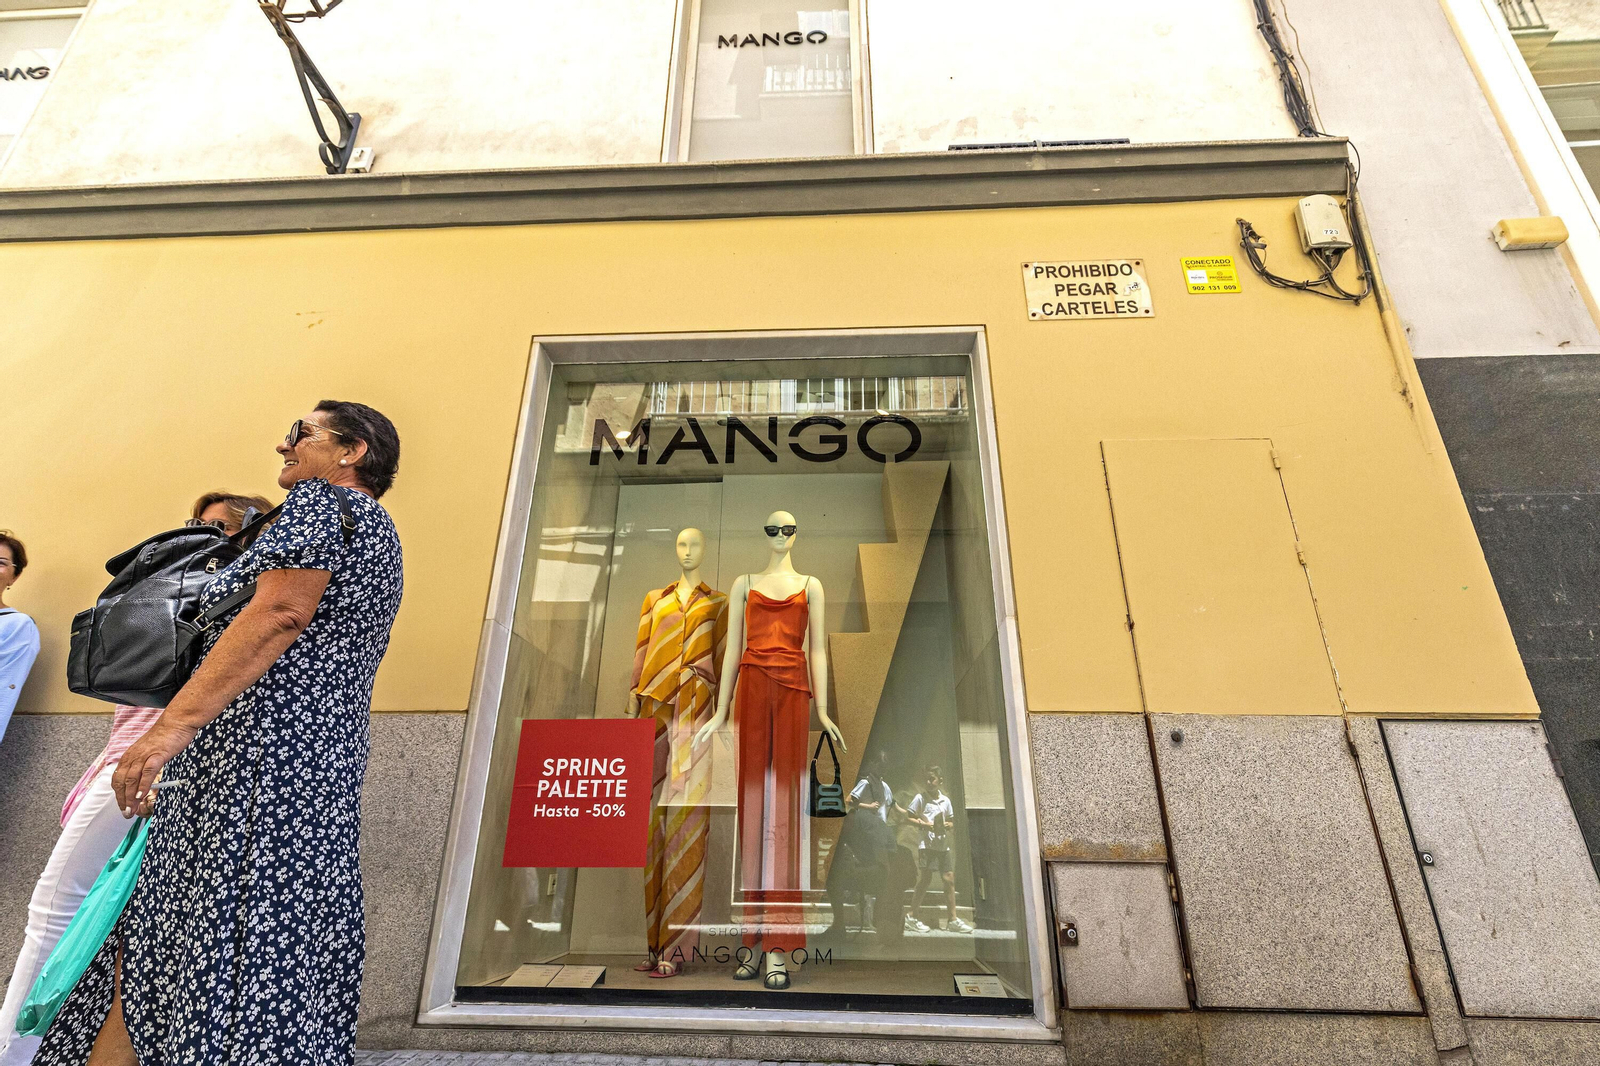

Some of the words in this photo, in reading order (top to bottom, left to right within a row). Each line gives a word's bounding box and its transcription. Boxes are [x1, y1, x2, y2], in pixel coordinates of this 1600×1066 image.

[717, 29, 828, 49] MANGO
[1034, 263, 1133, 279] PROHIBIDO
[1054, 282, 1118, 297] PEGAR
[1041, 300, 1139, 316] CARTELES
[589, 414, 922, 465] MANGO
[542, 757, 627, 776] SPRING
[536, 779, 628, 798] PALETTE
[533, 803, 579, 818] Hasta
[585, 803, 626, 818] -50%
[708, 927, 748, 937] SHOP
[753, 928, 772, 937] AT
